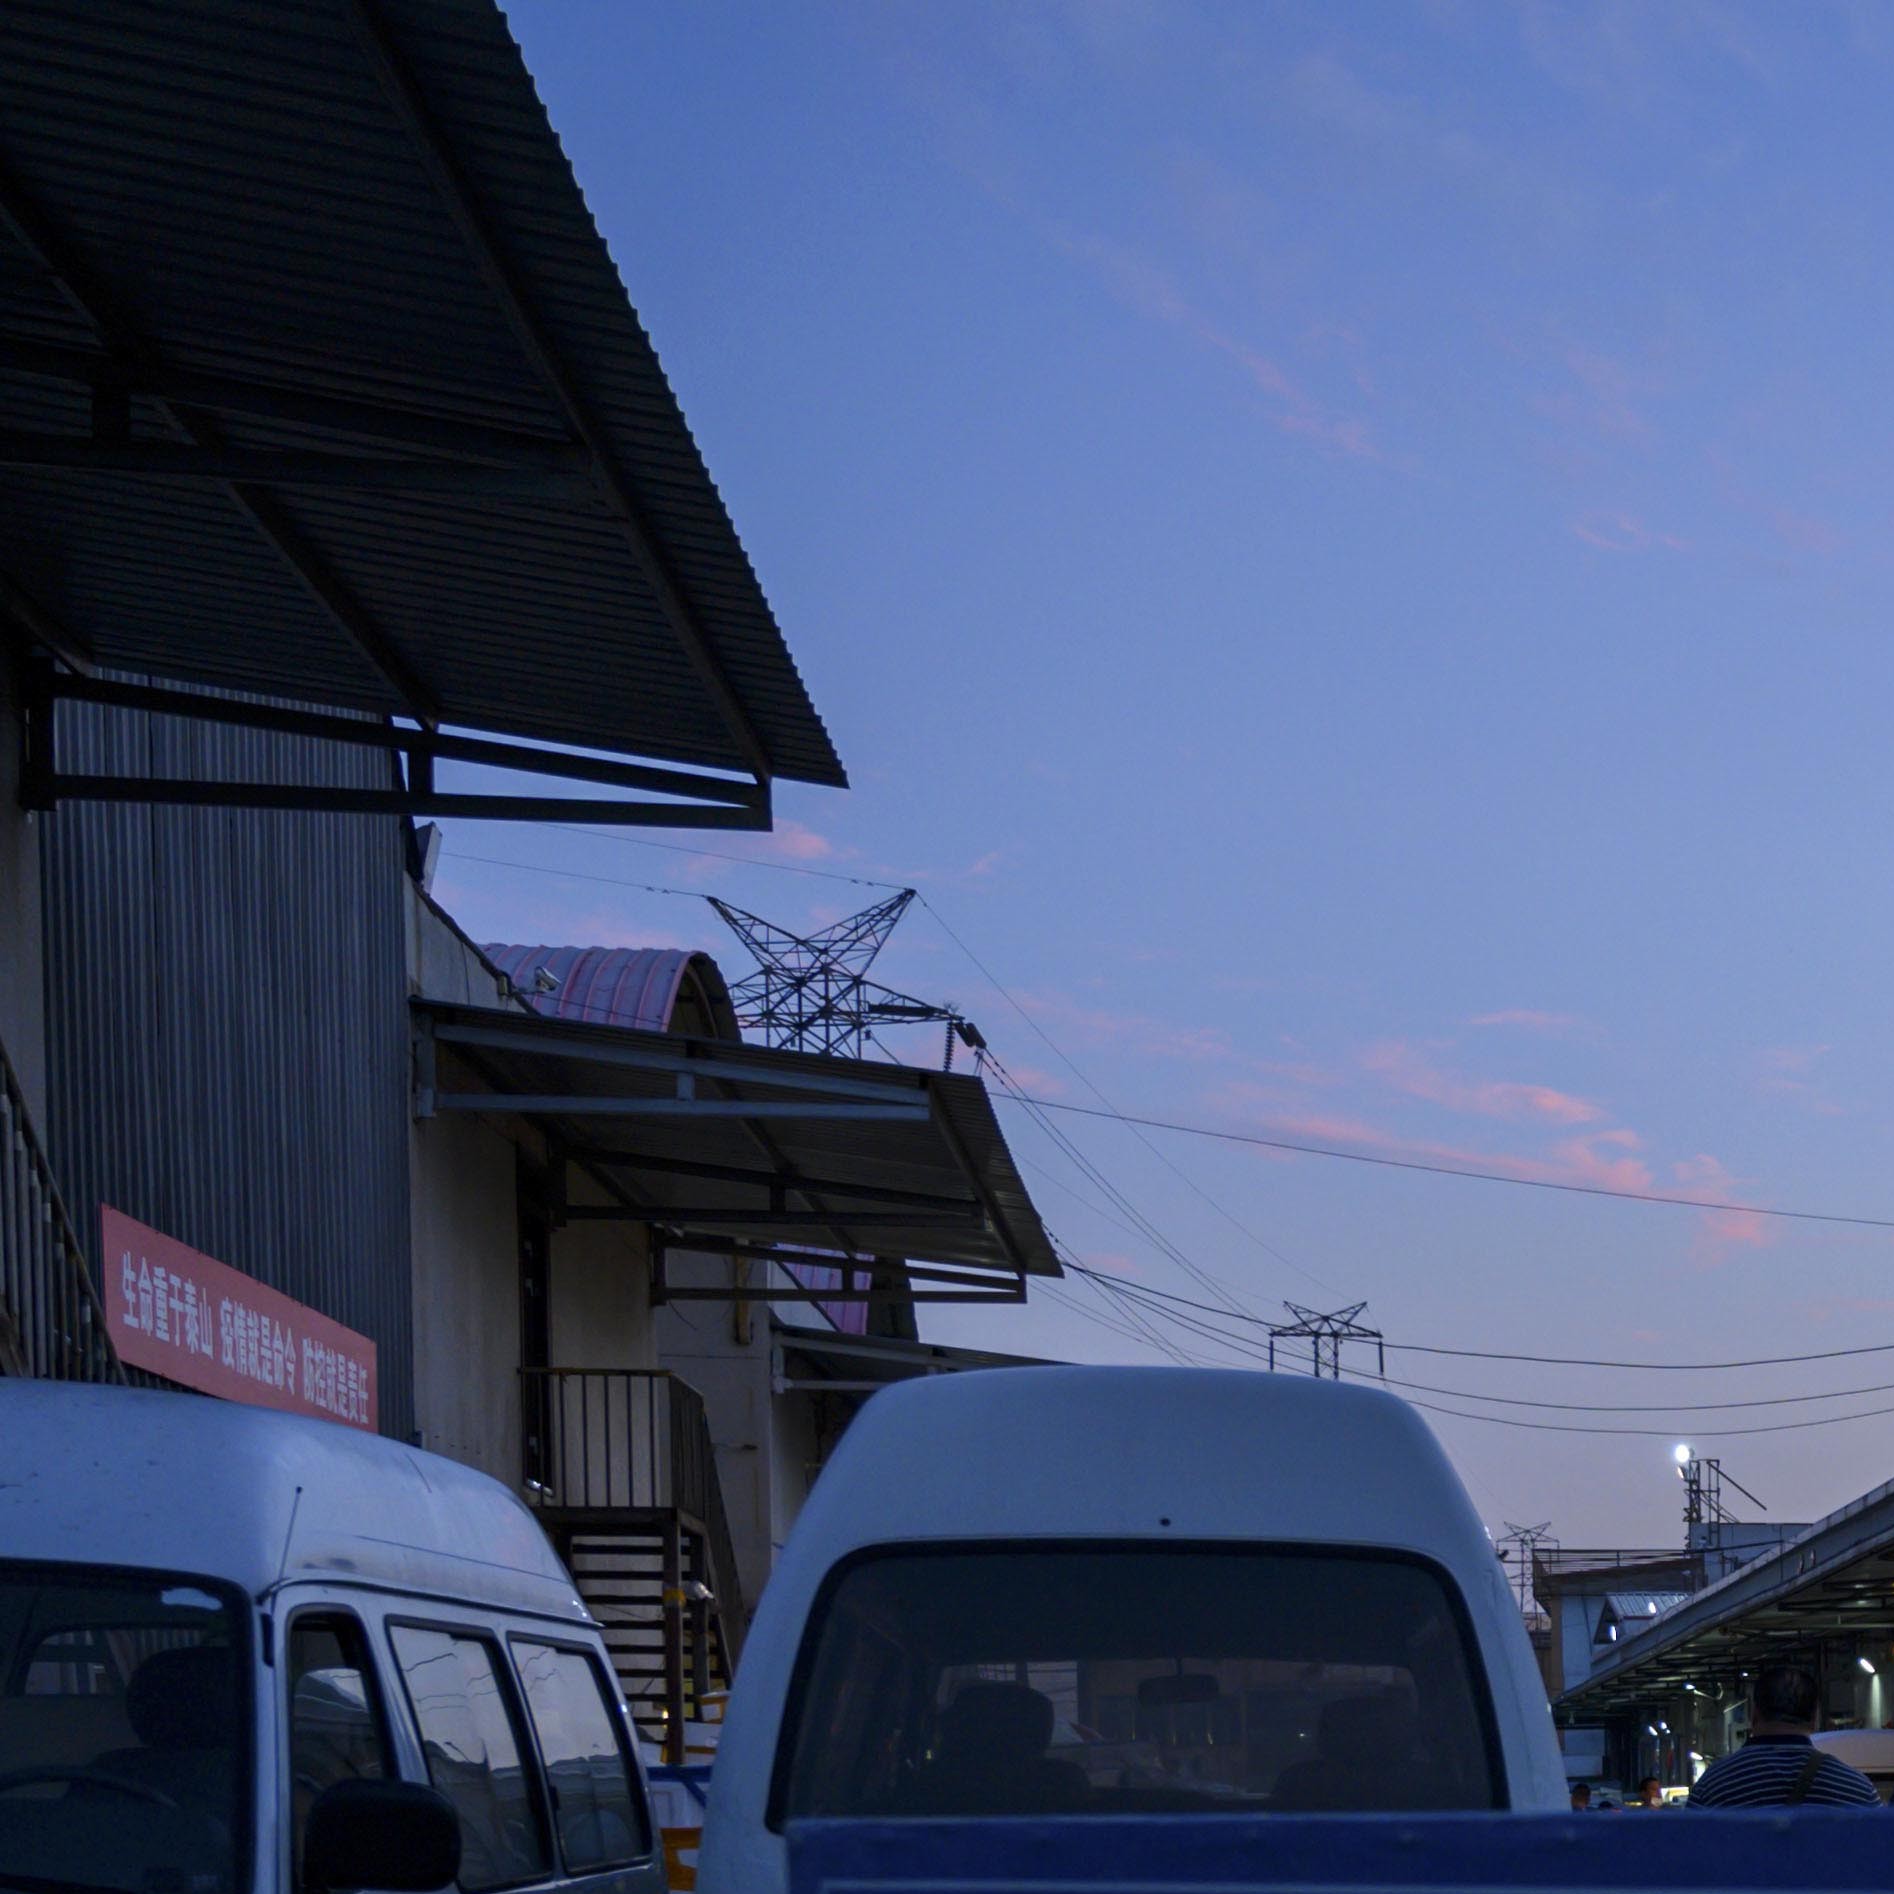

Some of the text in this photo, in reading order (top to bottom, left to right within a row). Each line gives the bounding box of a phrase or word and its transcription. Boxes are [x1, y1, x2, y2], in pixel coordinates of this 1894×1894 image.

[122, 1250, 369, 1424] 生命重于泰山 疫情就是命令 防控就是责任
